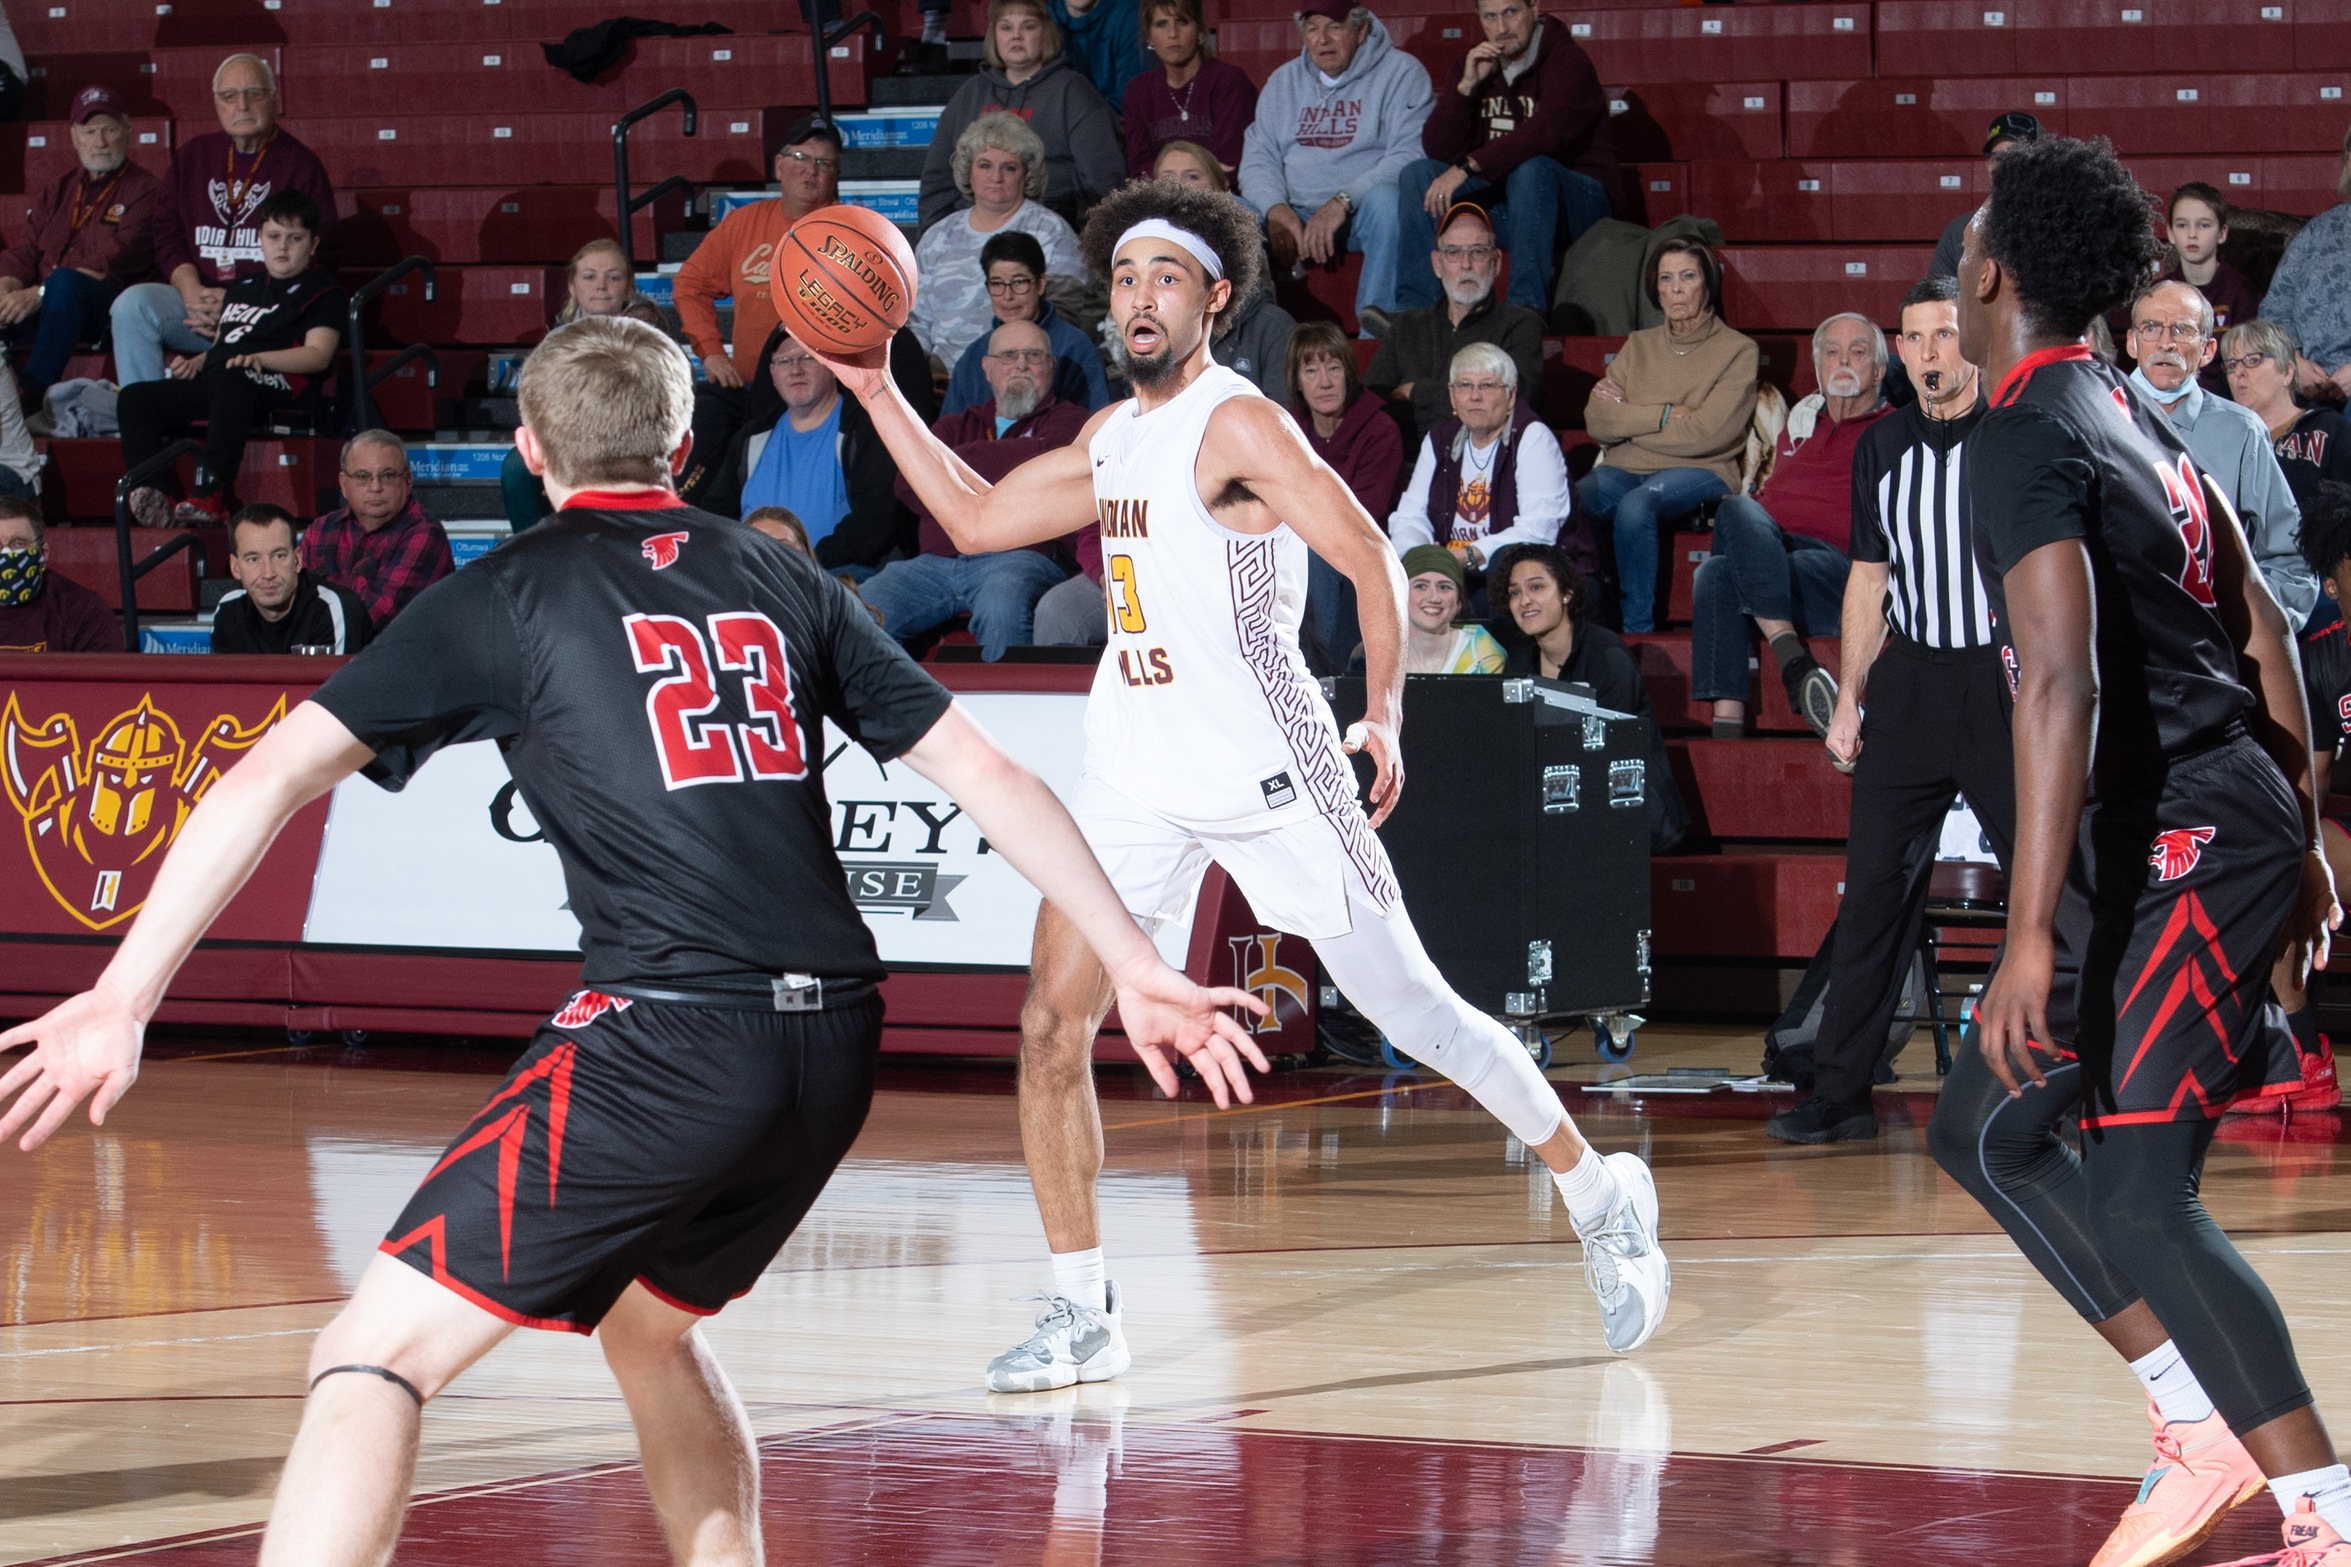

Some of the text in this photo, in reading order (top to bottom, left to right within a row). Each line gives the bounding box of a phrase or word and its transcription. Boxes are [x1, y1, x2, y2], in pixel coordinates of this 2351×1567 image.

[817, 234, 900, 313] SPALDING
[799, 268, 868, 330] LEGACY
[220, 303, 279, 324] HEAT
[809, 300, 851, 334] 1000
[224, 325, 253, 344] 6
[409, 460, 457, 473] Meridian
[1118, 647, 1174, 687] LLS
[622, 612, 809, 791] 23
[1267, 778, 1285, 792] XL
[2291, 1524, 2320, 1537] FREAK
